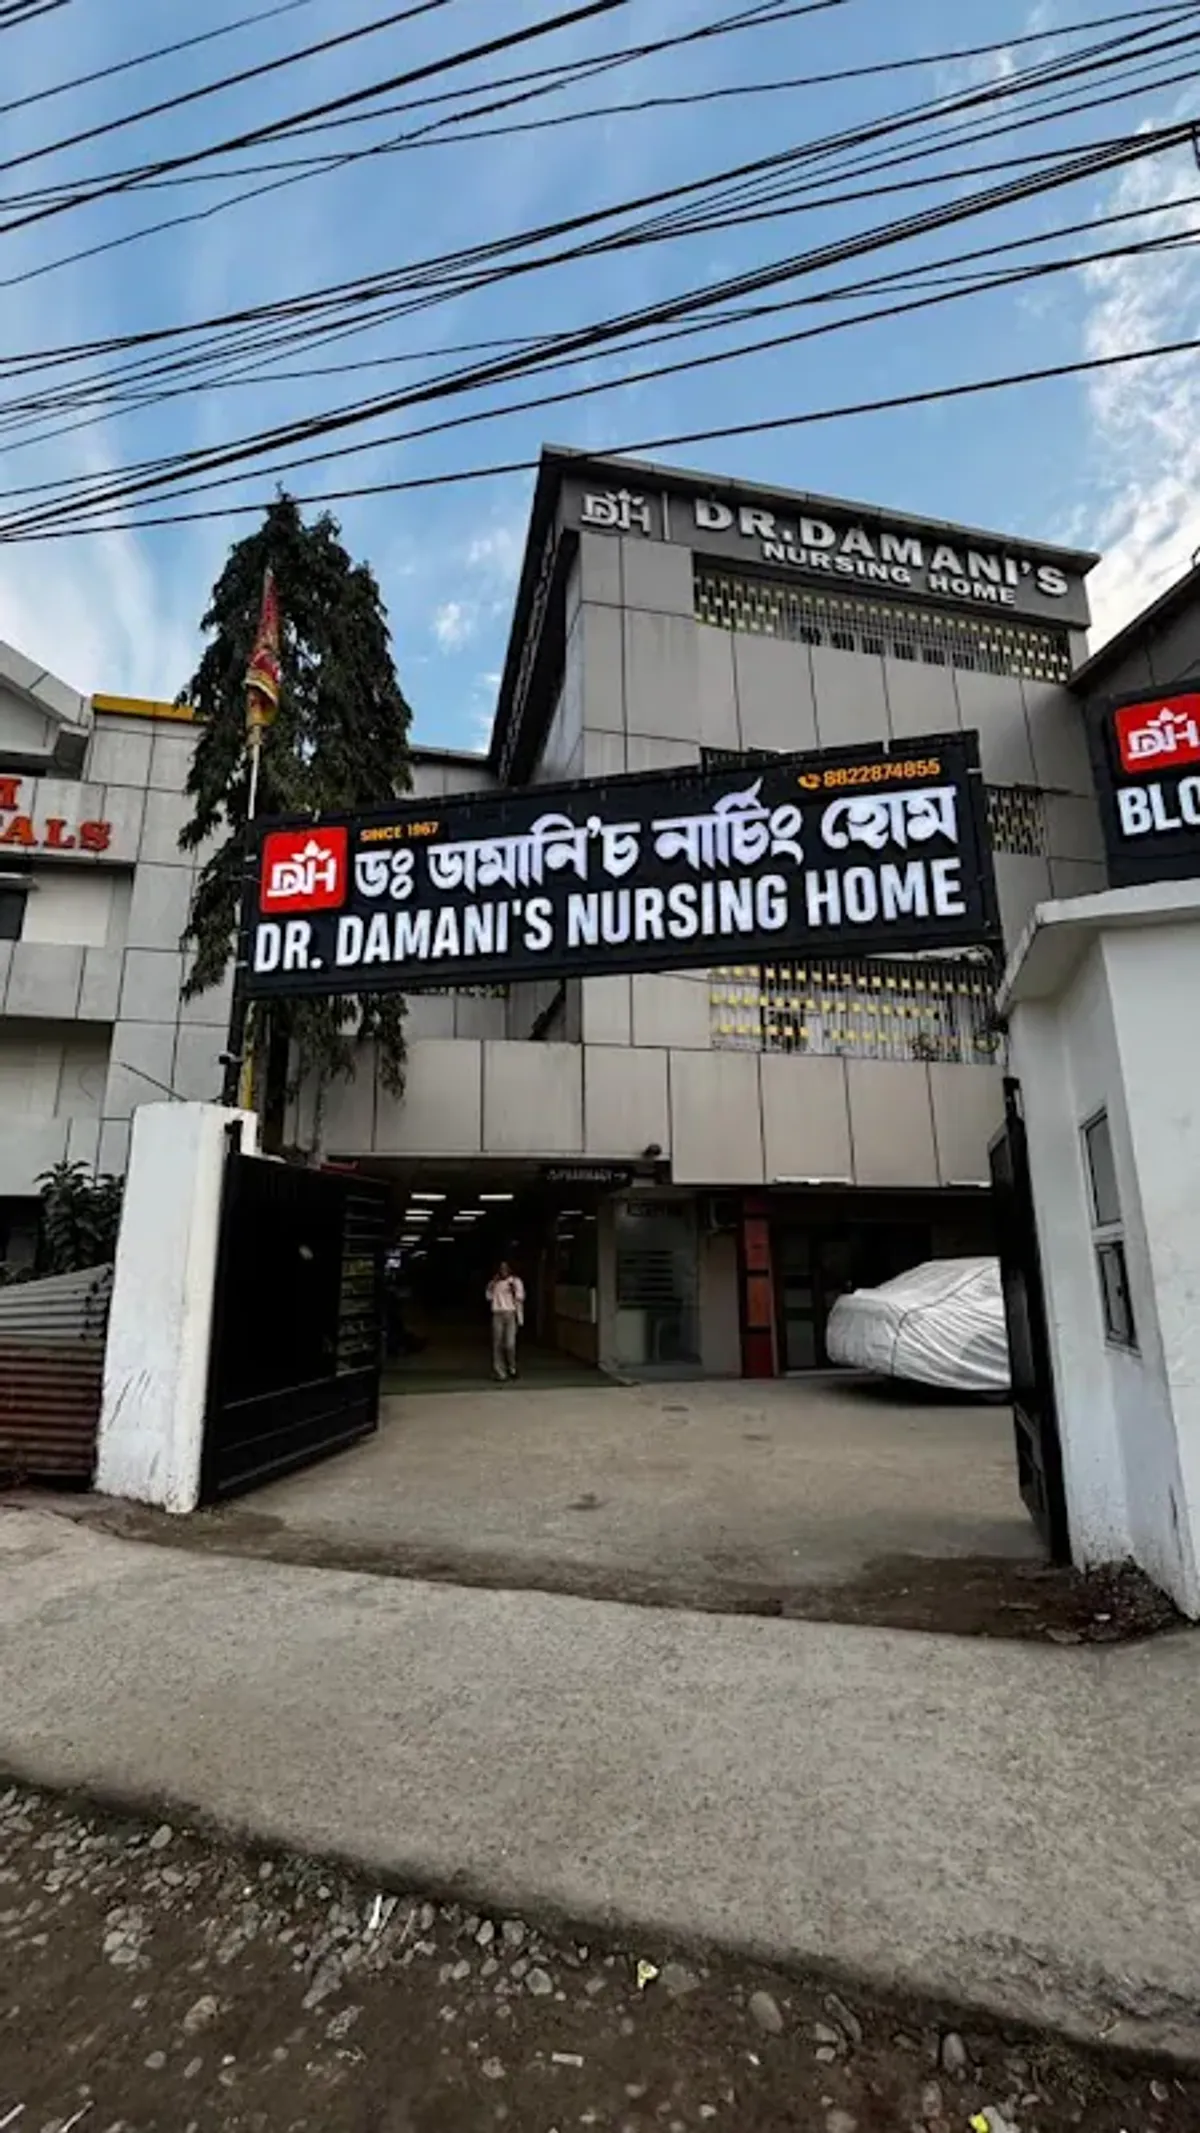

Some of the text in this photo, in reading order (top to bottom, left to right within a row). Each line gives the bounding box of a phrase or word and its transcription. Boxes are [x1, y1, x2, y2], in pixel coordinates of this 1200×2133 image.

[763, 541, 1016, 605] NURSING HOME
[0, 816, 111, 852] ALS
[360, 826, 404, 842] SINCE
[820, 785, 957, 850] হোম
[254, 858, 966, 973] DR. DAMANI'S NURSING HOME
